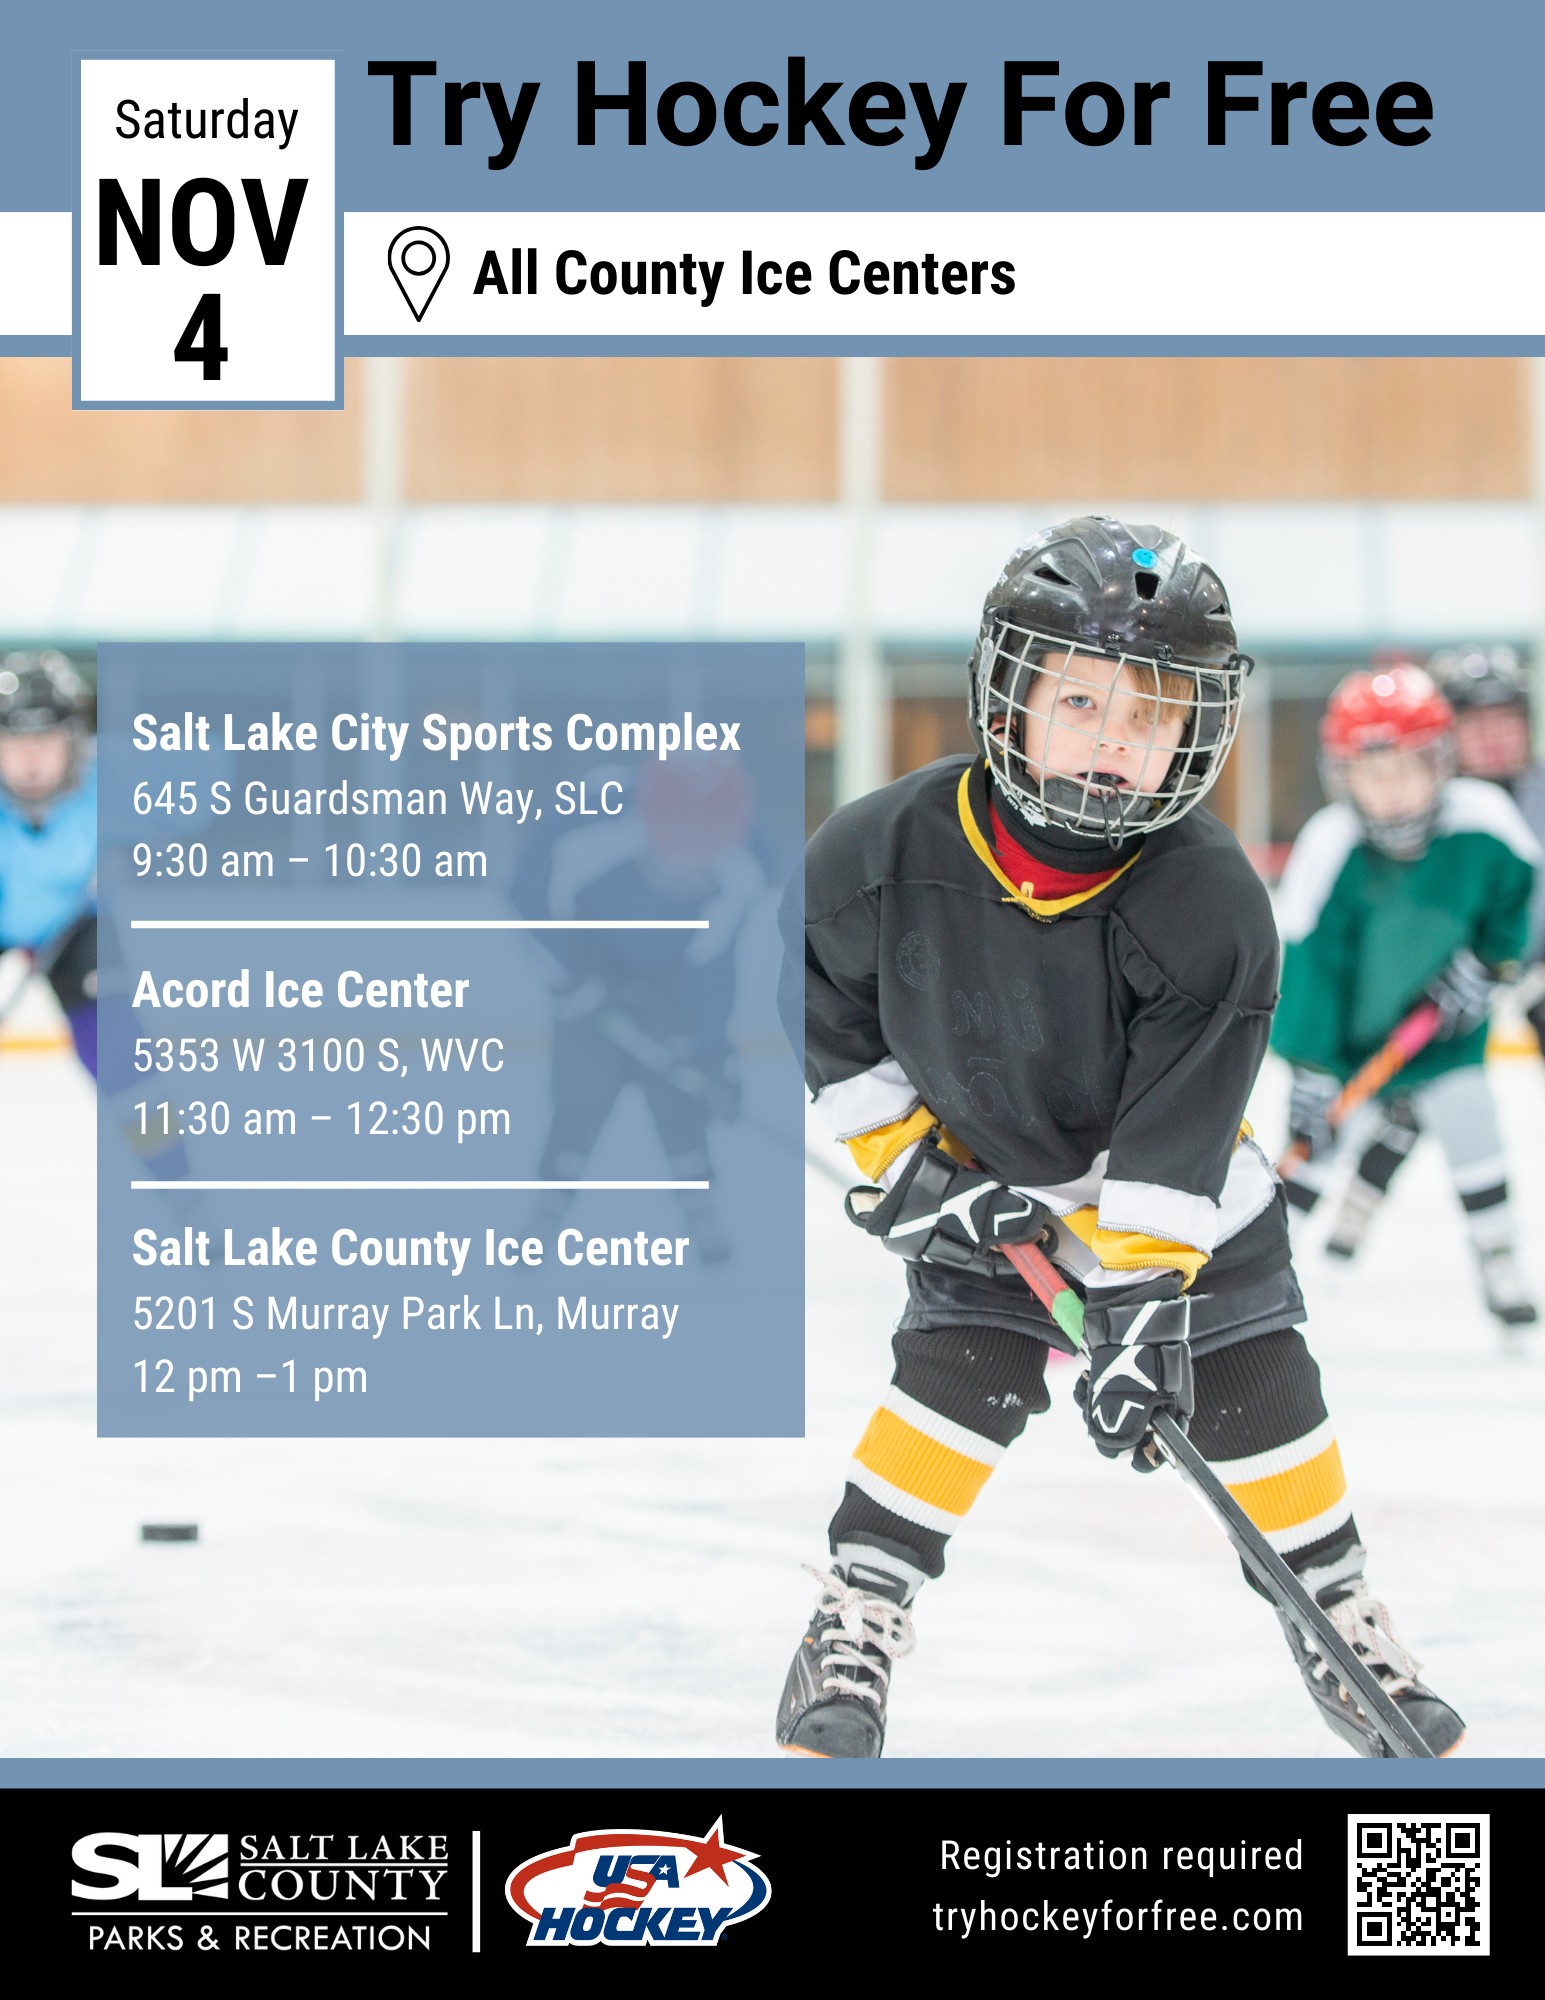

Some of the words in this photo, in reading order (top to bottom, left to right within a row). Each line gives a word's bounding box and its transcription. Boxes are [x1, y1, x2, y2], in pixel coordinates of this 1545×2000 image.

[115, 98, 298, 150] Saturday
[368, 61, 540, 170] Try
[578, 57, 967, 170] Hockey
[1005, 61, 1170, 147] For
[1208, 61, 1433, 147] Free
[99, 178, 308, 266] NOV
[473, 248, 537, 294] All
[556, 250, 724, 307] County
[743, 250, 812, 295] Ice
[830, 250, 1015, 295] Centers
[174, 294, 228, 380] 4
[132, 712, 210, 751] Salt
[224, 712, 317, 751] Lake
[331, 712, 409, 760] City
[422, 713, 553, 760] Sports
[566, 712, 741, 760] Complex
[132, 781, 197, 815] 645
[210, 781, 231, 815] S
[245, 780, 447, 815] Guardsman
[461, 781, 542, 825] Way,
[555, 781, 624, 815] SLC
[132, 843, 208, 877] 9:30
[221, 852, 273, 877] am
[325, 843, 421, 877] 10:30
[434, 852, 488, 877] am
[132, 969, 250, 1008] Acord
[265, 970, 324, 1008] Ice
[337, 969, 470, 1008] Center
[134, 1037, 219, 1072] 5353
[232, 1039, 265, 1072] W
[278, 1037, 365, 1072] 3100
[377, 1037, 408, 1078] S,
[421, 1037, 504, 1072] WVC
[134, 1101, 230, 1135] 11:30
[244, 1109, 296, 1135] am
[347, 1101, 444, 1135] 12:30
[457, 1109, 511, 1144] pm
[132, 1227, 210, 1267] Salt
[224, 1227, 317, 1267] Lake
[331, 1228, 472, 1276] County
[485, 1228, 544, 1267] Ice
[557, 1228, 690, 1267] Center
[134, 1296, 216, 1330] 5201
[232, 1296, 254, 1330] S
[268, 1296, 390, 1339] Murray
[403, 1295, 482, 1330] Park
[494, 1296, 543, 1336] Ln,
[557, 1296, 680, 1339] Murray
[134, 1359, 175, 1393] 12
[188, 1367, 242, 1402] pm
[314, 1367, 368, 1402] pm
[240, 1835, 335, 1861] SALT
[347, 1835, 449, 1860] LAKE
[941, 1839, 1147, 1877] Registration
[1163, 1839, 1302, 1877] required
[239, 1869, 448, 1901] COUNTY
[590, 1855, 680, 1893] USA
[89, 1925, 184, 1951] PARKS
[197, 1925, 221, 1951] &
[235, 1925, 430, 1951] RECREATION
[532, 1907, 734, 1941] HOCKEY
[932, 1899, 1302, 1939] tryhockeyforfree.com
